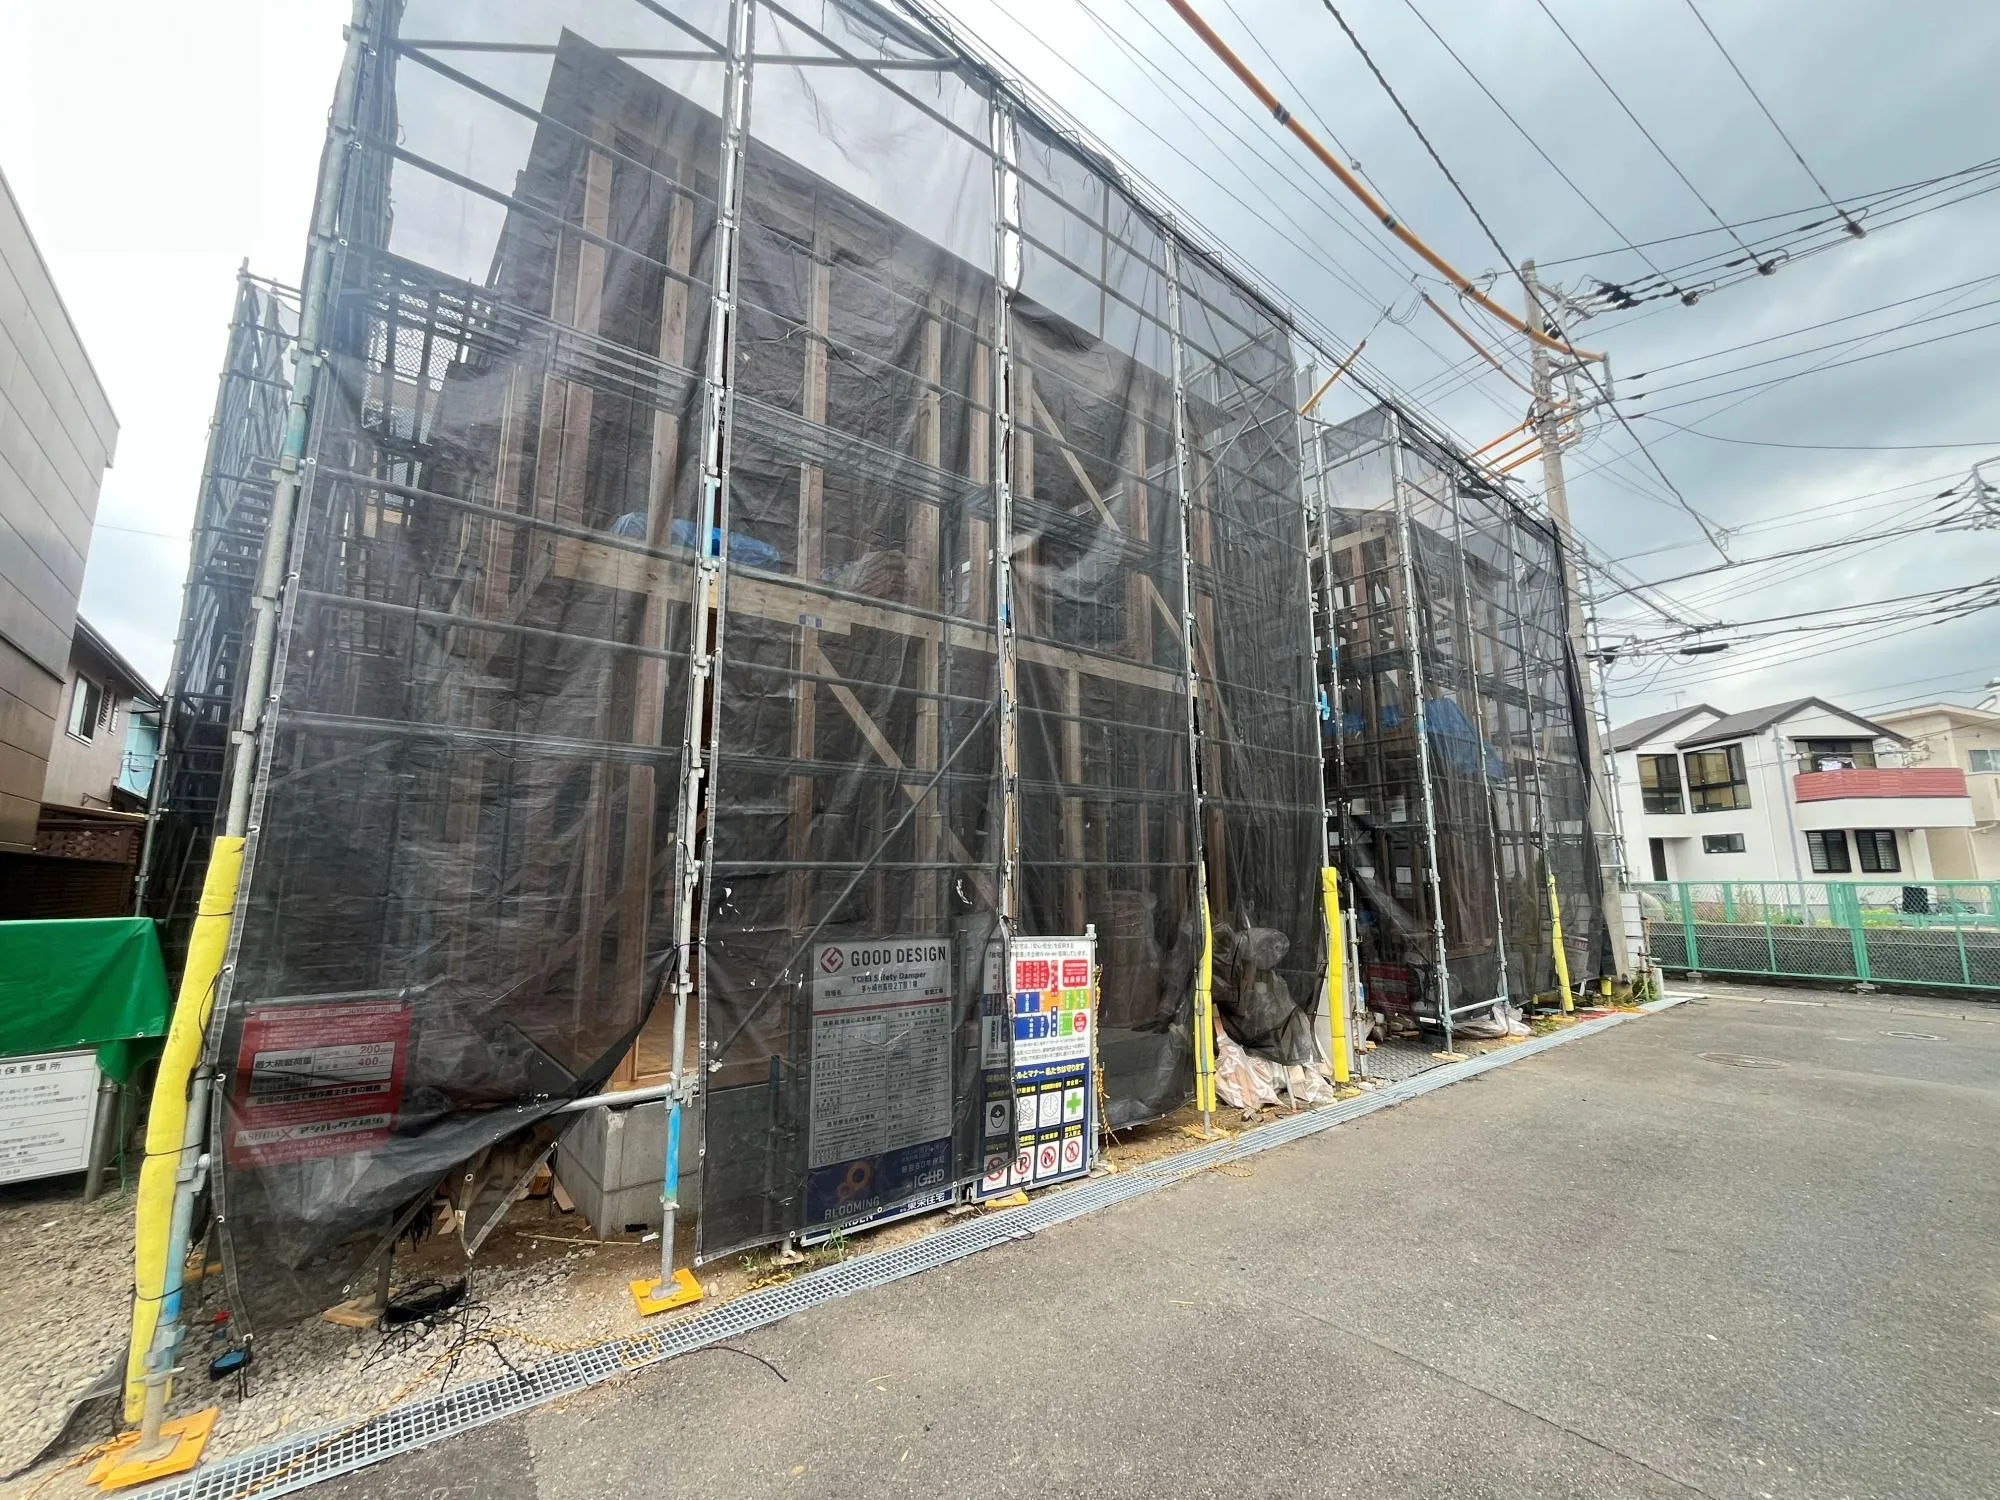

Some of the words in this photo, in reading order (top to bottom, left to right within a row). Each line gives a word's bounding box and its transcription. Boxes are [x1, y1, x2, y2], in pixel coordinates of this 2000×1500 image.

[851, 949, 892, 967] GOOD
[896, 946, 946, 964] DESIGN
[899, 971, 926, 981] Damper
[360, 1044, 380, 1054] 200
[358, 1057, 379, 1066] 400
[0, 1061, 62, 1076] 保管場所
[824, 1195, 881, 1221] BLOOMING
